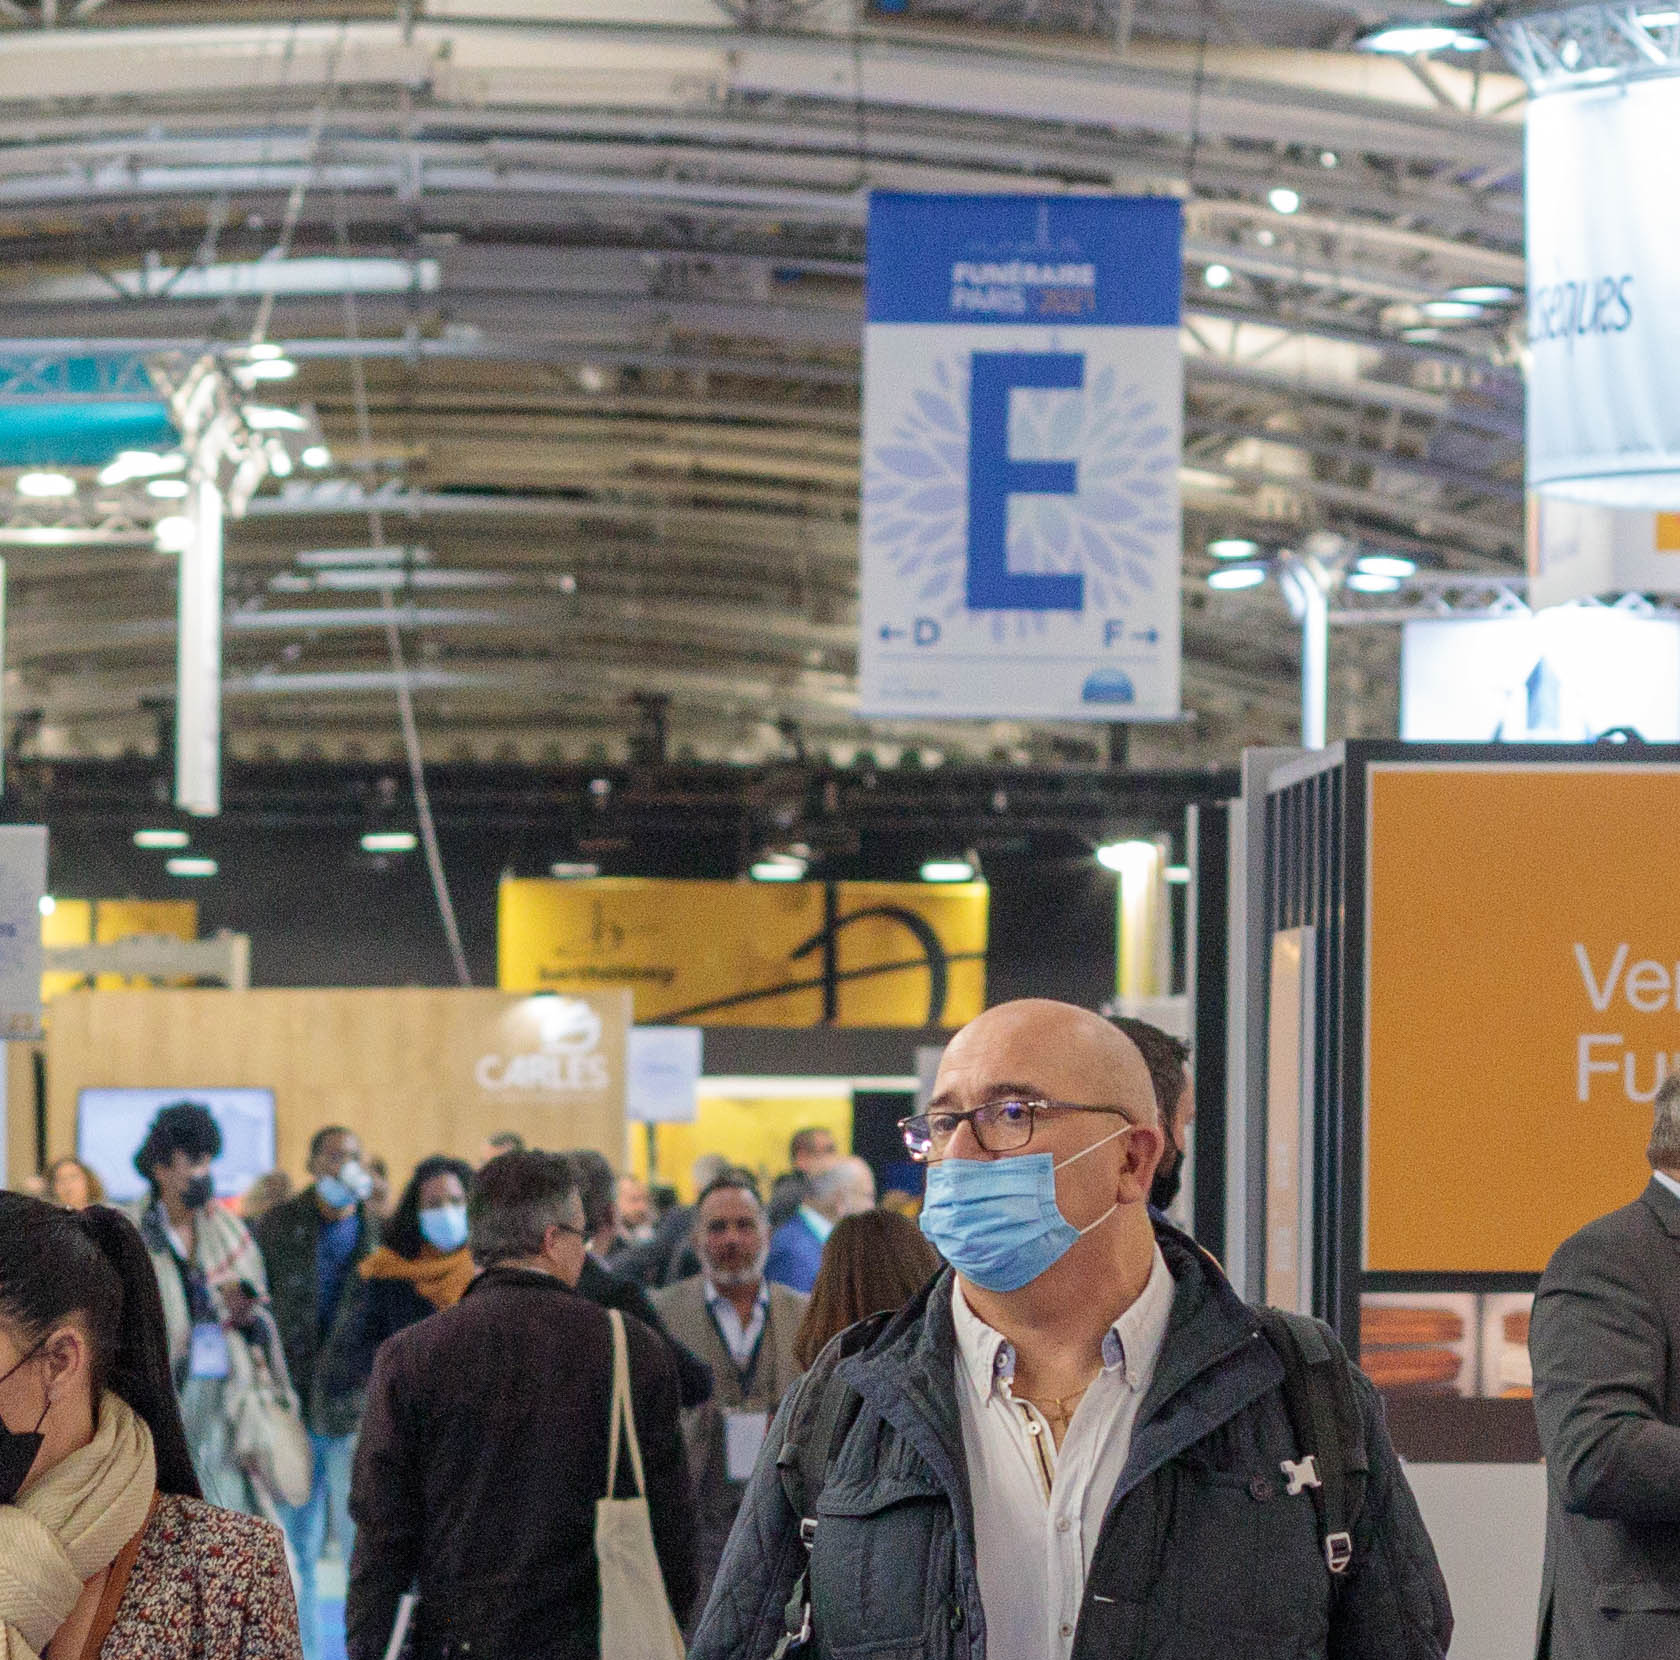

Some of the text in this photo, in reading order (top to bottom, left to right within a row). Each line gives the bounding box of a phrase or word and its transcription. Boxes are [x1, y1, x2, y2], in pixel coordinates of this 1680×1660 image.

[965, 351, 1086, 612] E
[914, 616, 941, 648] D
[1104, 618, 1124, 648] F
[474, 1054, 609, 1091] CARLES
